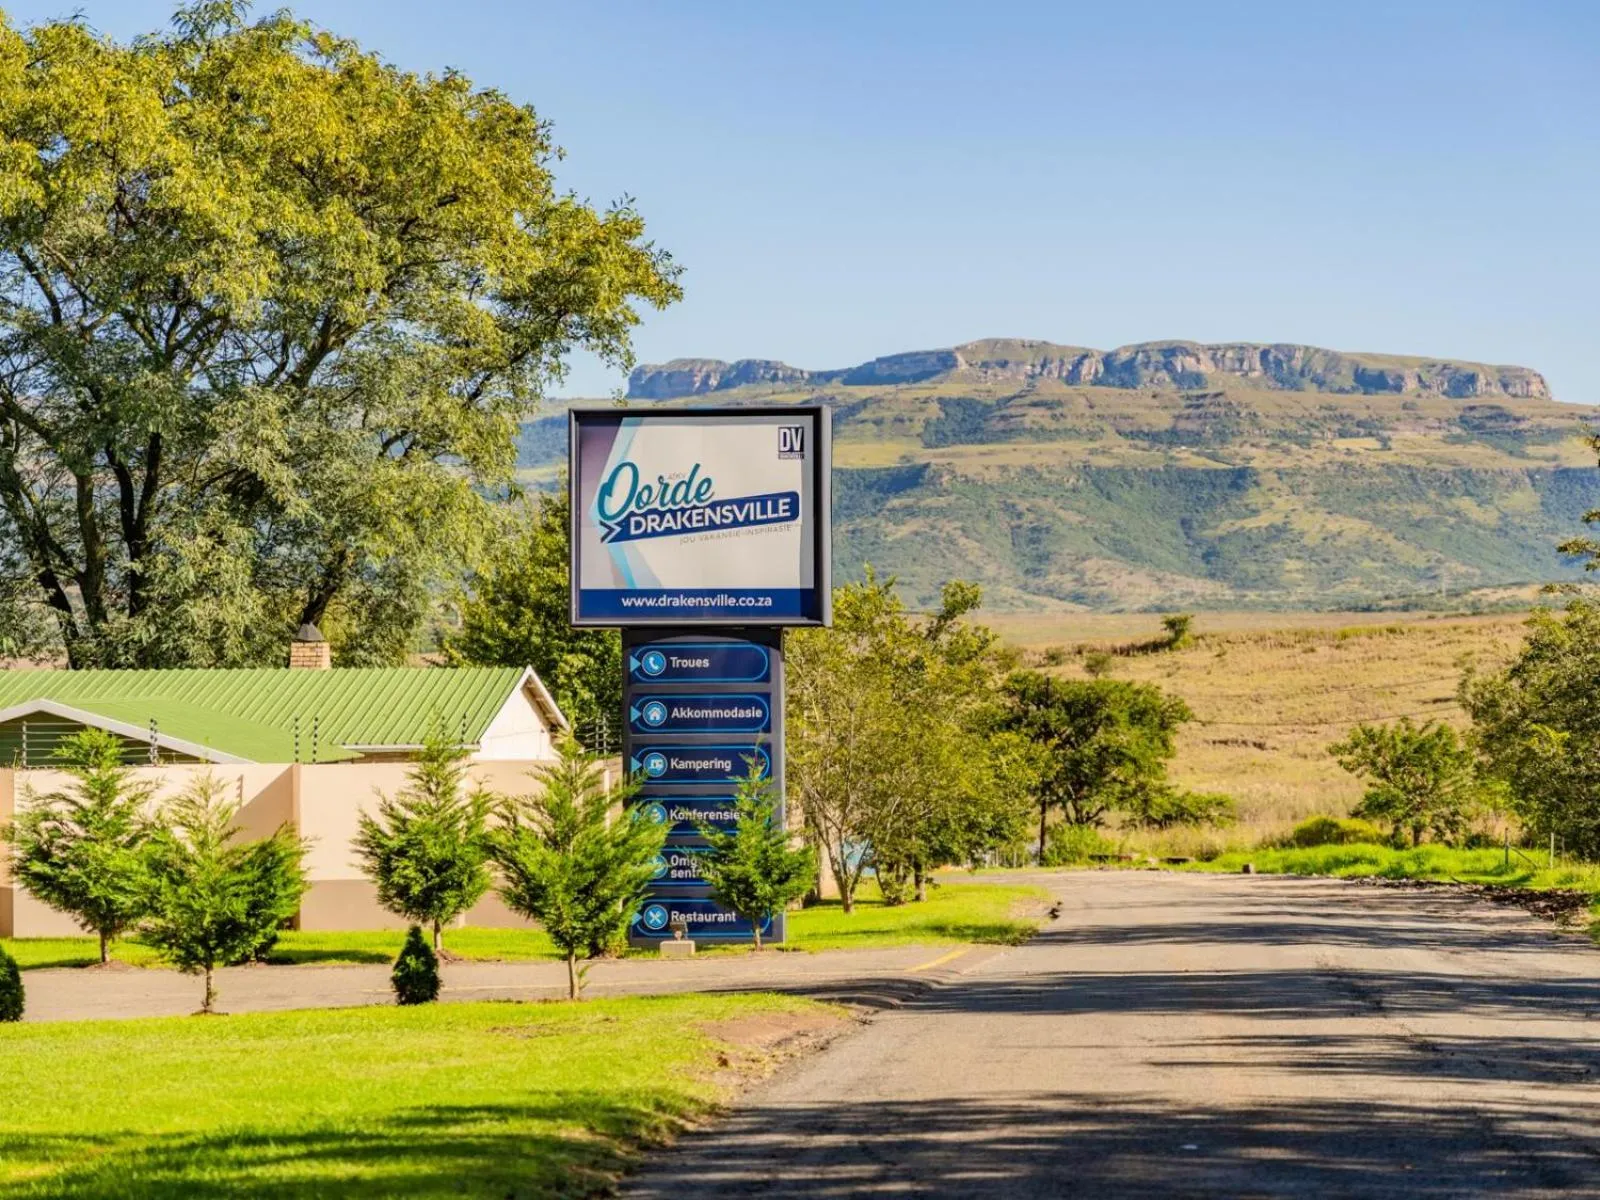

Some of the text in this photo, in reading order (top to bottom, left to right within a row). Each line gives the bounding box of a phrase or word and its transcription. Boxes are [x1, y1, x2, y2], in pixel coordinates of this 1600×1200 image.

[779, 428, 803, 452] DV
[597, 461, 715, 522] Oorde
[629, 497, 792, 536] DRAKENSVILLE
[622, 594, 773, 607] www.drakensville.co.za
[670, 656, 710, 668] Troues
[671, 706, 764, 719] Akkommodasie
[670, 757, 732, 771] Kampering
[671, 911, 737, 923] Restaurant
